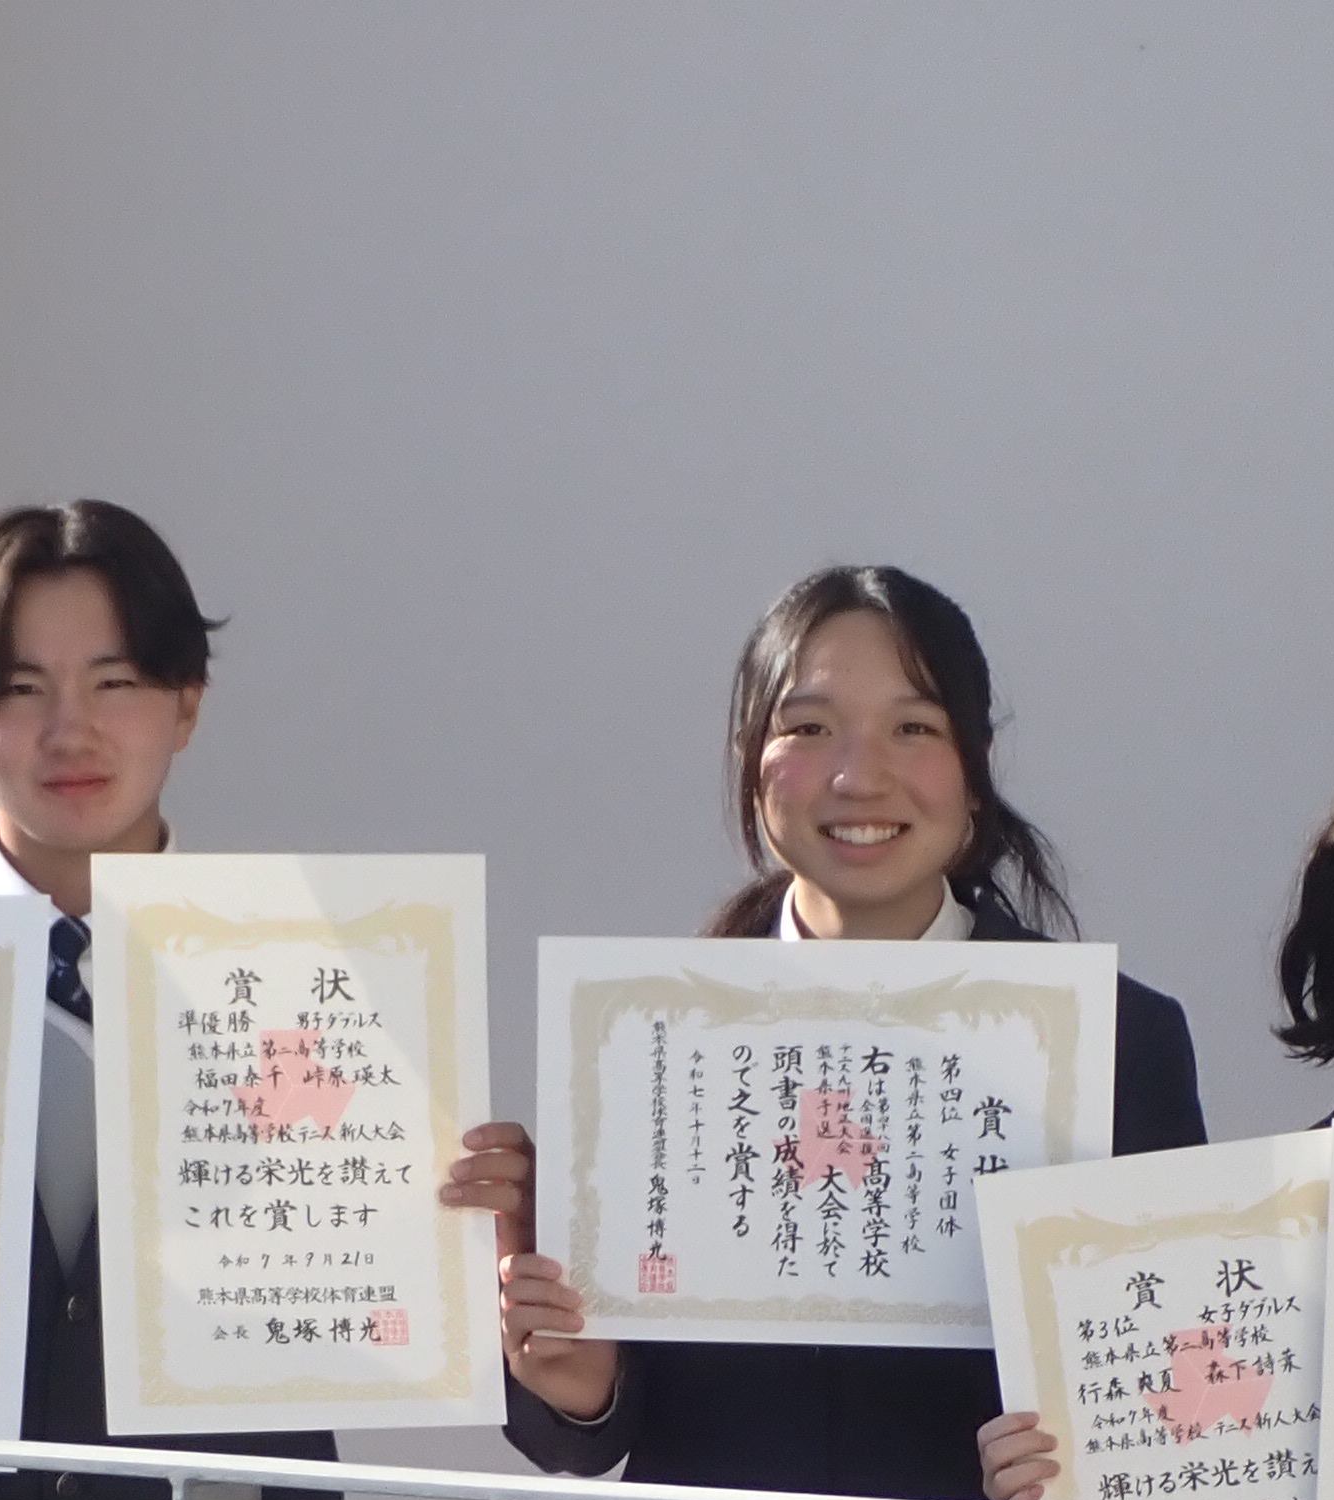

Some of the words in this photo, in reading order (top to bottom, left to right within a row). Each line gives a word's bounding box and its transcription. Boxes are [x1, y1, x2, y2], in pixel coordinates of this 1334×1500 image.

[225, 967, 355, 1007] 賞状
[177, 1009, 256, 1036] 準優勝
[297, 1011, 383, 1030] 男子ダブルス
[182, 1096, 270, 1118] 令和7年度
[940, 1052, 963, 1124] 第四位
[178, 1156, 413, 1188] 輝ける栄光を讃えて
[770, 1045, 804, 1278] 頭書の成績を得た
[936, 1143, 963, 1239] 女子団体
[185, 1199, 379, 1232] これを賞します
[1126, 1258, 1264, 1311] 賞状
[211, 1325, 250, 1342] 会長
[1077, 1315, 1140, 1342] 第3位
[1198, 1296, 1302, 1324] 女子ダブルス
